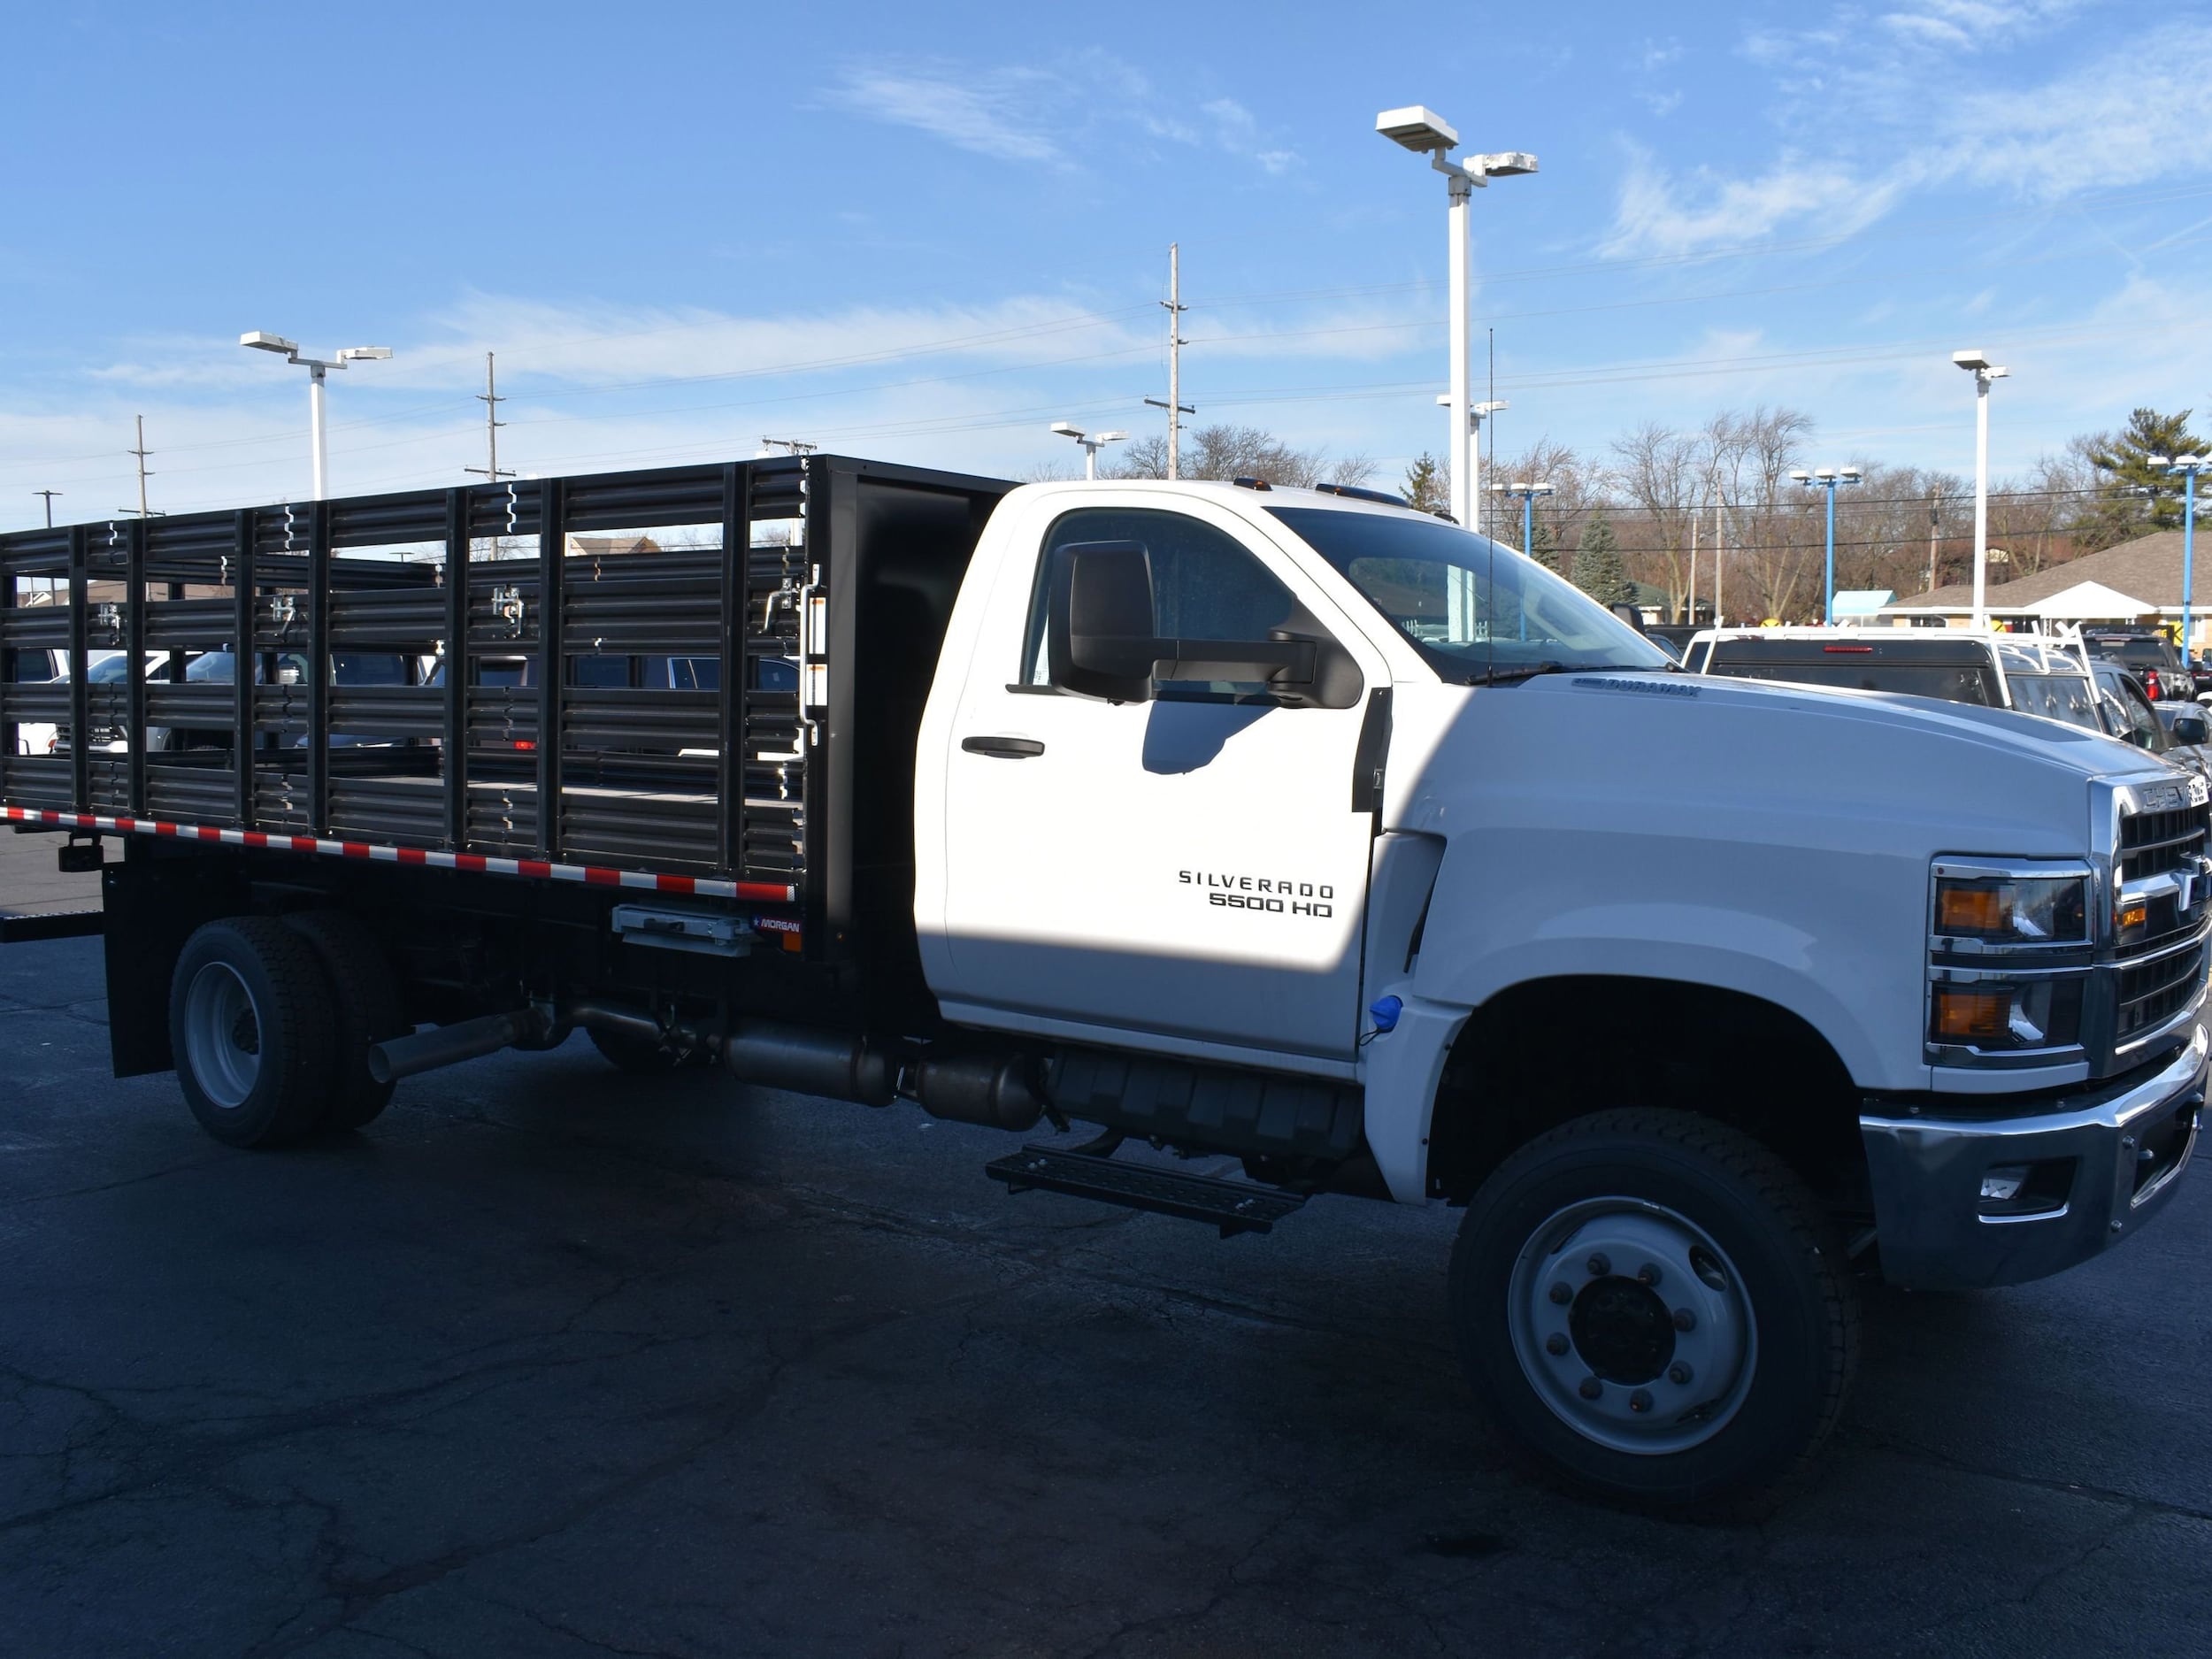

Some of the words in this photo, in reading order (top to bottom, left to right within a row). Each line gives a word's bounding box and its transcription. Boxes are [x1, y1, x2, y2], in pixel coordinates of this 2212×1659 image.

[1605, 679, 1701, 697] DURAMAX
[1179, 870, 1333, 899] SILVERADO
[1209, 892, 1284, 913] 5500
[1292, 901, 1333, 918] HD
[761, 918, 800, 933] MORGAN
